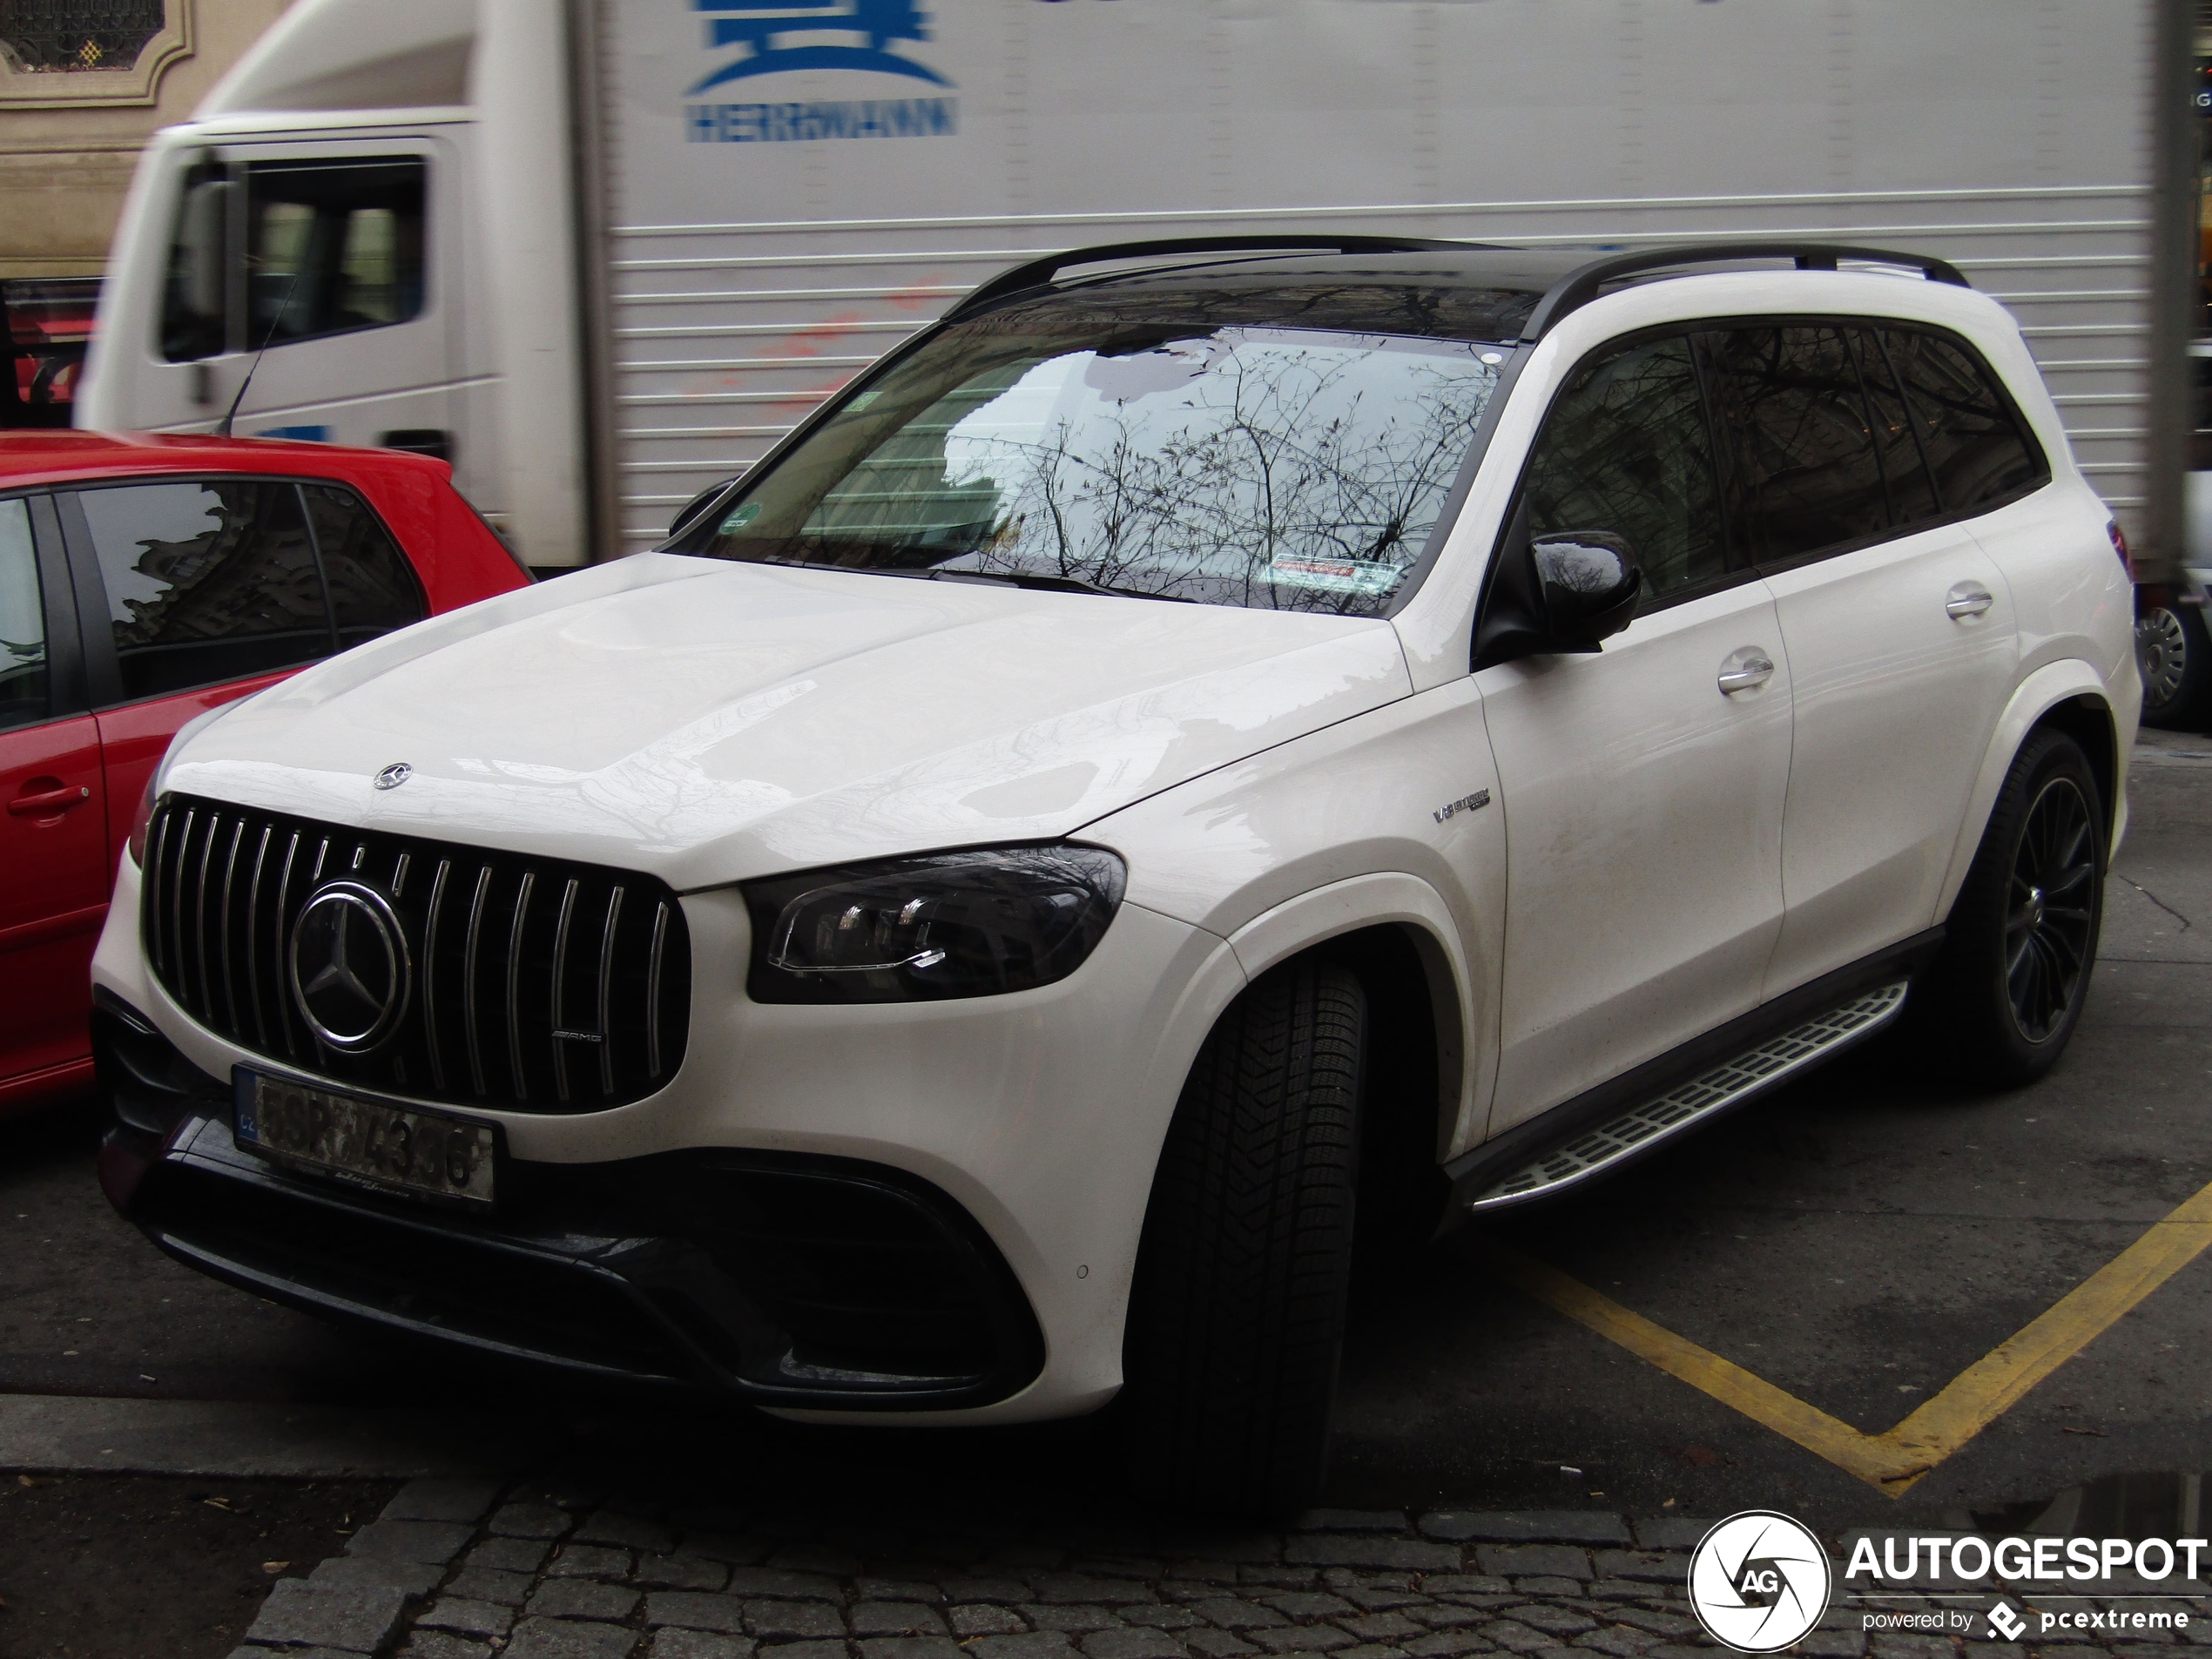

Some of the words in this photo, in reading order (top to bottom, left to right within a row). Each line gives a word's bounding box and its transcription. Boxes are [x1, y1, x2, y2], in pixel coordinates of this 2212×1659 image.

[684, 98, 960, 143] HERRMANN
[566, 1032, 602, 1043] AMG
[240, 1114, 255, 1132] CZ
